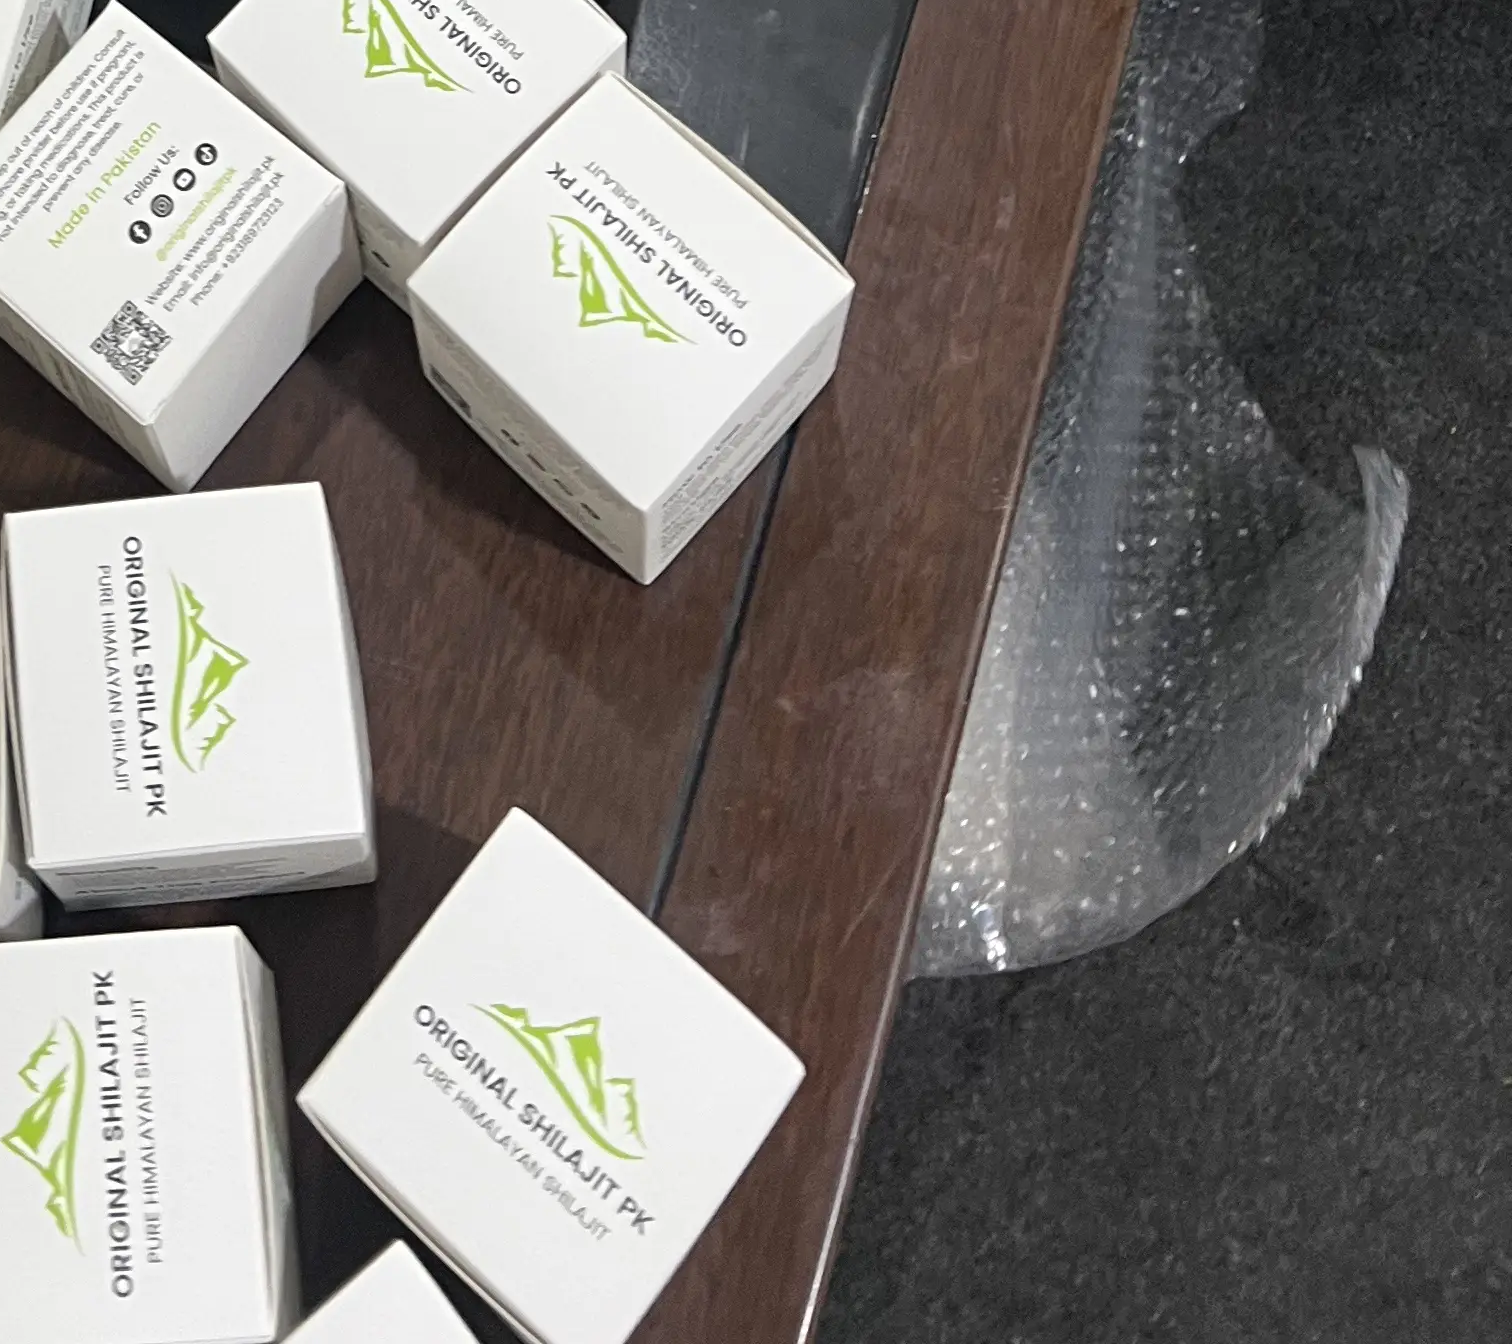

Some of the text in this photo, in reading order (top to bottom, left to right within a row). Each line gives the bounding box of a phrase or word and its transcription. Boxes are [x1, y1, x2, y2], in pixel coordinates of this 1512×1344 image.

[439, 16, 520, 93] ORIGINAL
[47, 122, 161, 248] Made in Pakistan
[123, 145, 180, 205] Follow Us:
[545, 162, 746, 346] ORIGINAL SHILAJIT PK
[583, 161, 748, 308] PURE HIMALAYAN SHILAJIT
[123, 536, 166, 815] ORIGINAL SHILAJIT PK
[93, 971, 132, 1297] ORIGINAL SHILAJIT PK
[414, 1005, 654, 1234] ORIGINAL SHILAJIT PK
